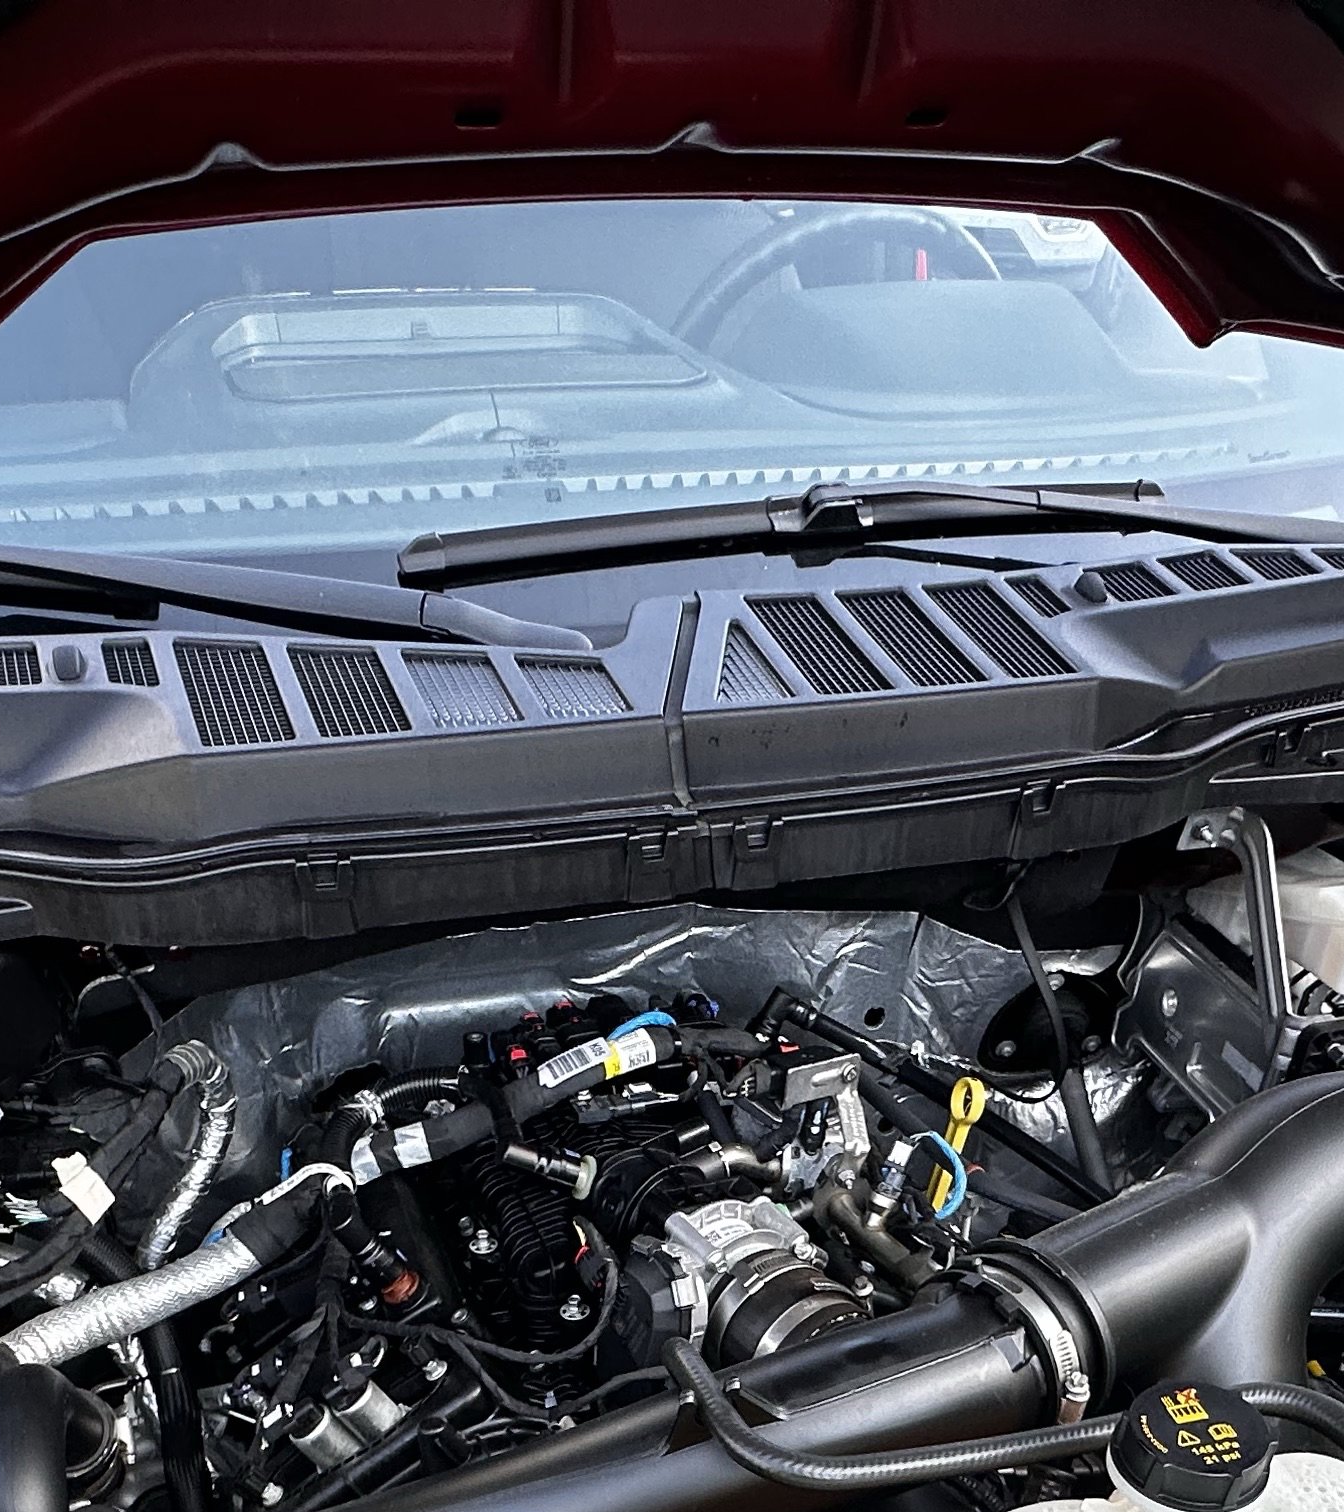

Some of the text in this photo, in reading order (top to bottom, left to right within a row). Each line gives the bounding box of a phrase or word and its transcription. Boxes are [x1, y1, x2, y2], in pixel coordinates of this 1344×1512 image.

[1215, 1441, 1241, 1451] kPa
[1203, 1450, 1242, 1465] 21 psi
